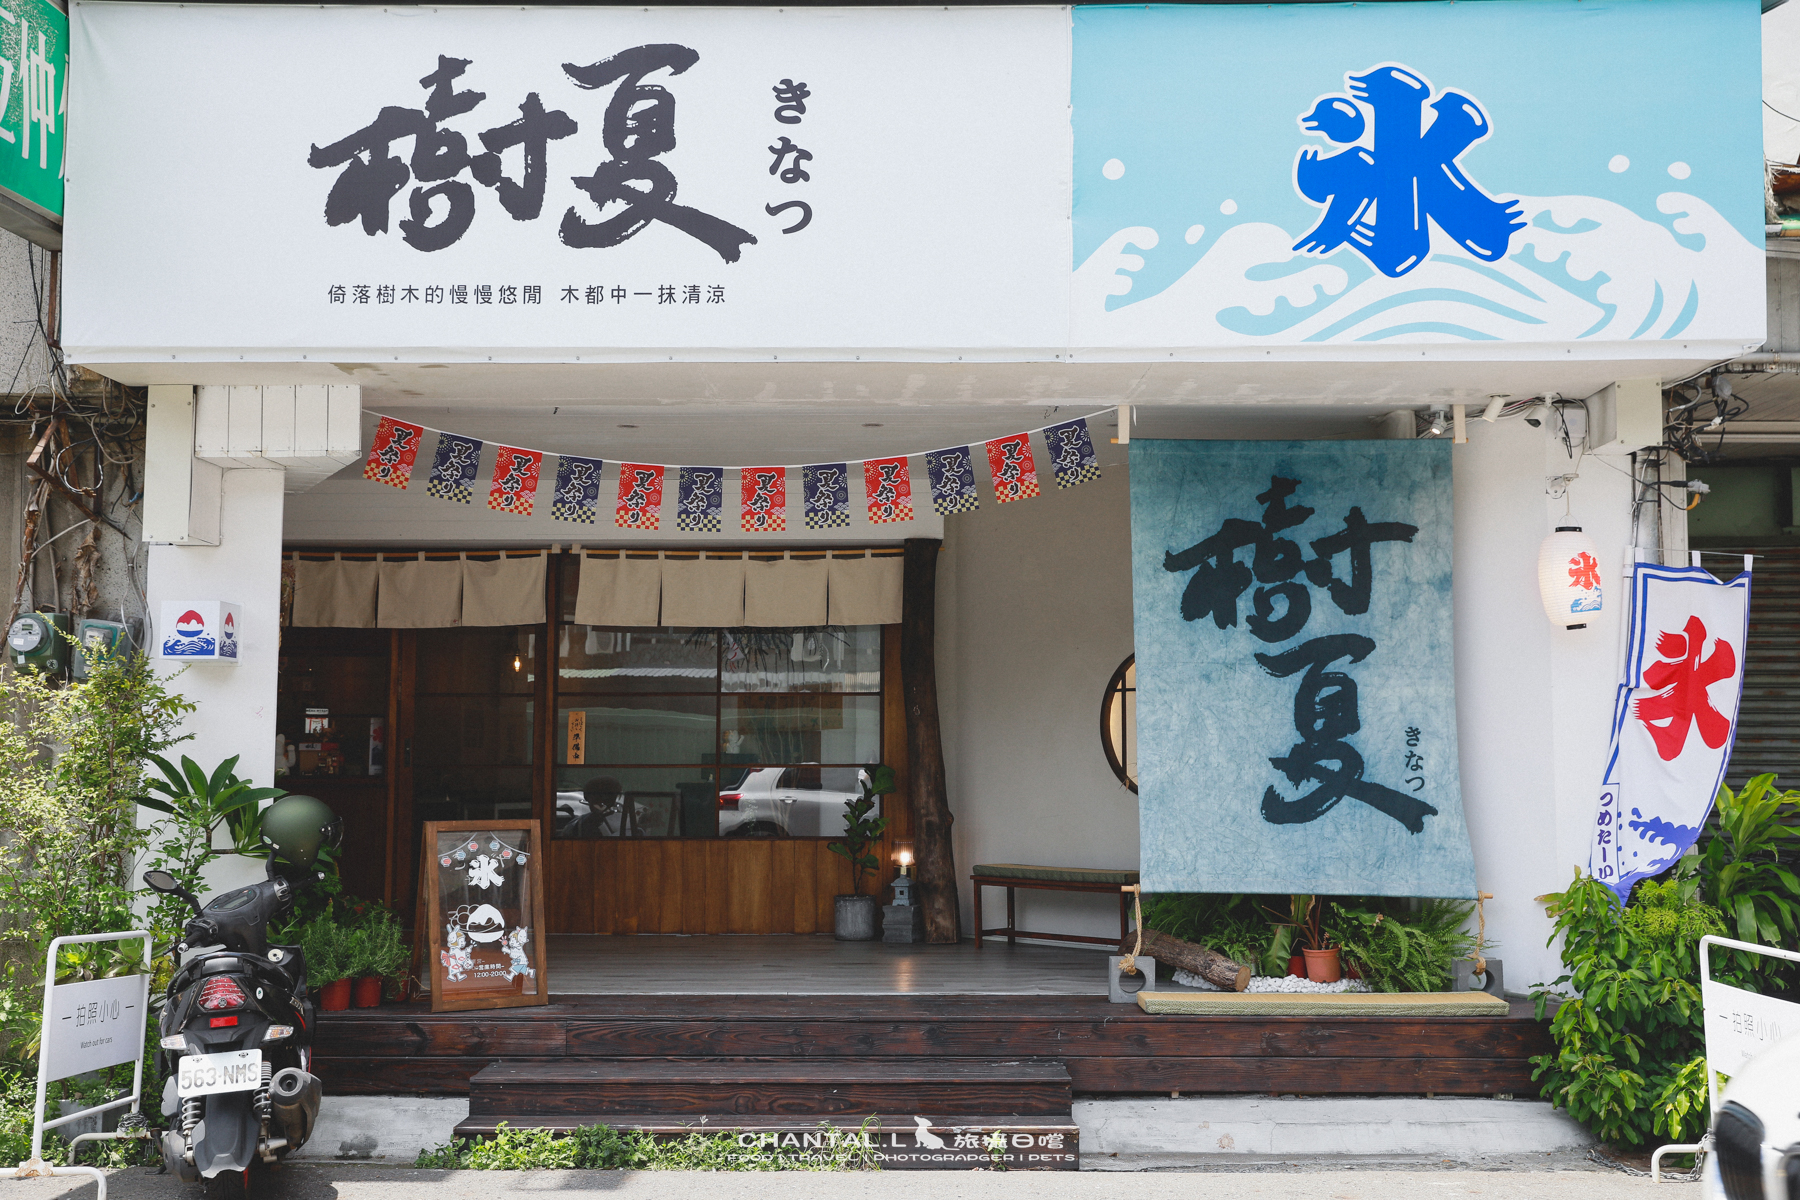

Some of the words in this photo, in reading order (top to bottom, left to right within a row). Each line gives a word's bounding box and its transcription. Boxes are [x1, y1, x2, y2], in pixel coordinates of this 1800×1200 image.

[765, 77, 814, 235] きなつ
[327, 284, 543, 305] 倚落樹木的慢慢悠閒
[560, 284, 727, 305] 木都中一抹清涼
[1404, 725, 1426, 792] きなつ
[1597, 791, 1614, 880] つめたーい
[76, 999, 119, 1028] 拍照小心
